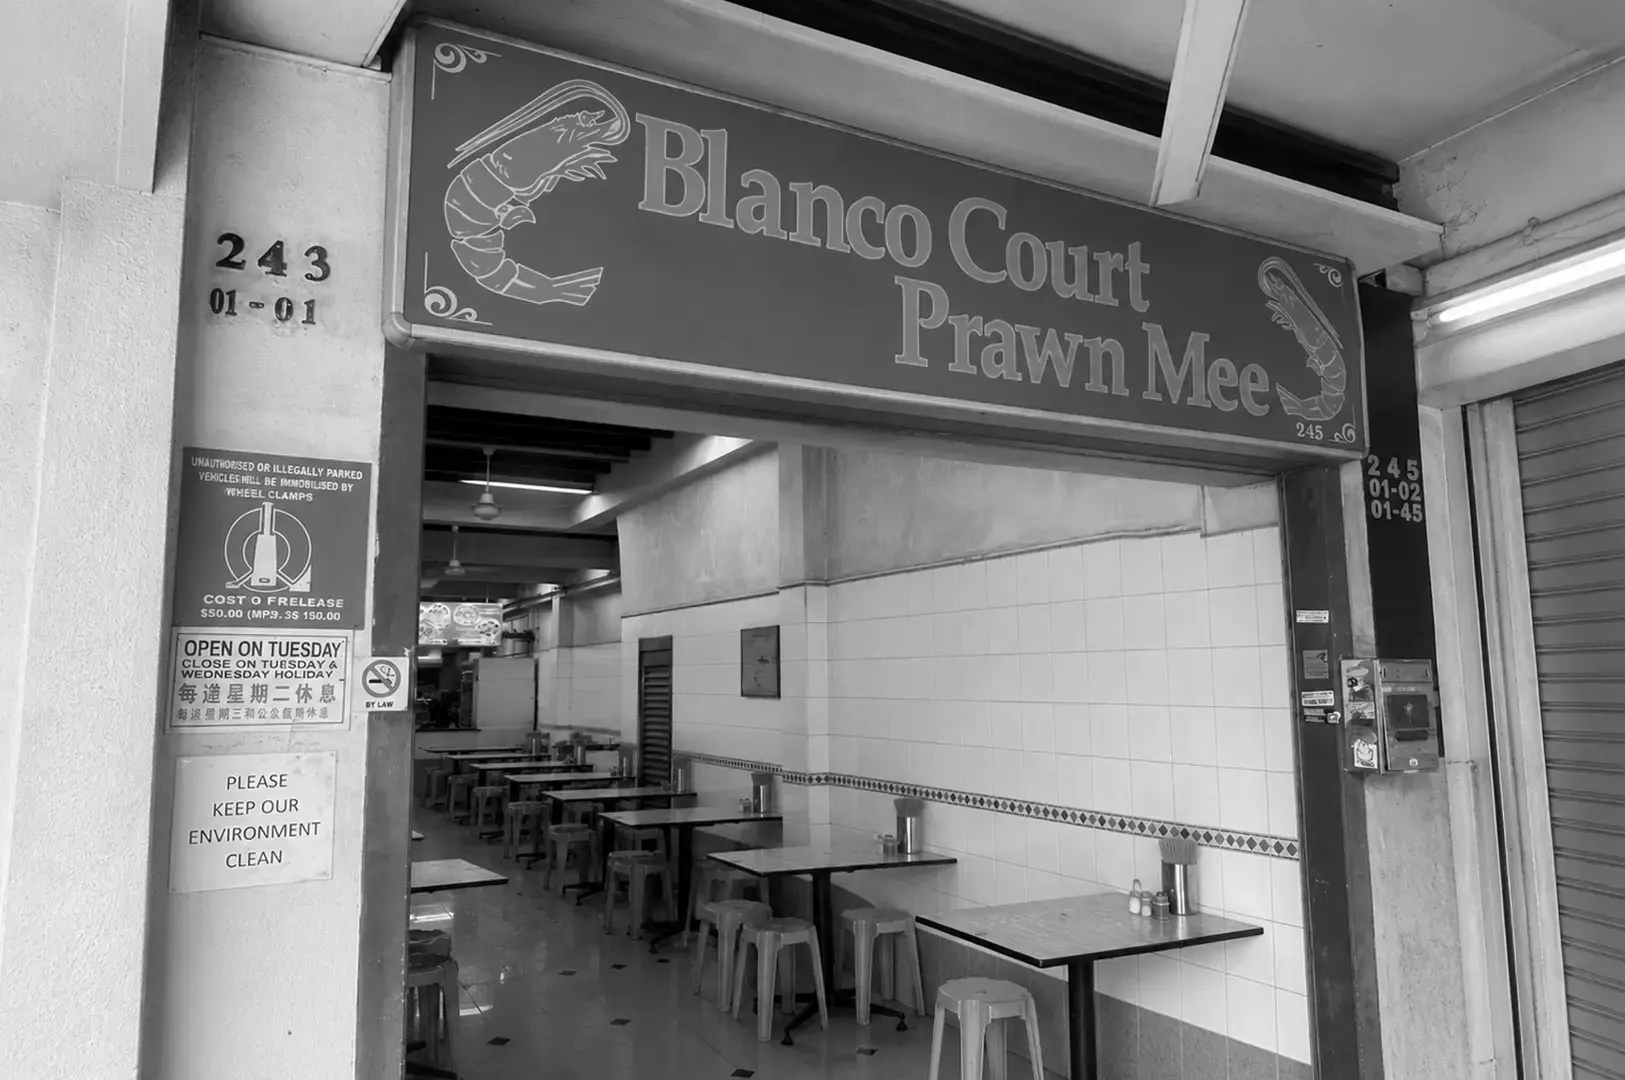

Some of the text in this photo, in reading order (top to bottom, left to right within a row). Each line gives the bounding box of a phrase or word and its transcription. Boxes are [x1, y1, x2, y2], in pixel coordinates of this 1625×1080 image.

[635, 112, 1151, 313] Blanco Court
[894, 274, 1271, 417] Prawn Mee
[1296, 422, 1324, 441] 245
[191, 456, 364, 480] UNAUTHORISED OR ILLEGALLY PARKED
[1367, 454, 1420, 481] 245
[264, 476, 278, 487] BE
[341, 482, 355, 492] BY
[1369, 478, 1422, 501] 01-02
[267, 490, 314, 502] CLAMPS
[1370, 499, 1423, 523] 01-45
[203, 594, 247, 606] COST
[184, 639, 342, 659] OPEN ON TUESDAY
[181, 659, 231, 669] CLOSE
[235, 660, 257, 669] ON
[261, 660, 326, 670] TUESDAY
[181, 669, 334, 680] WEDNESDAY HOLIDAY
[226, 773, 289, 791] PLEASE
[212, 798, 300, 818] KEEP OUR
[188, 821, 322, 846] ENVIRONMENT
[224, 849, 283, 869] CLEAN
